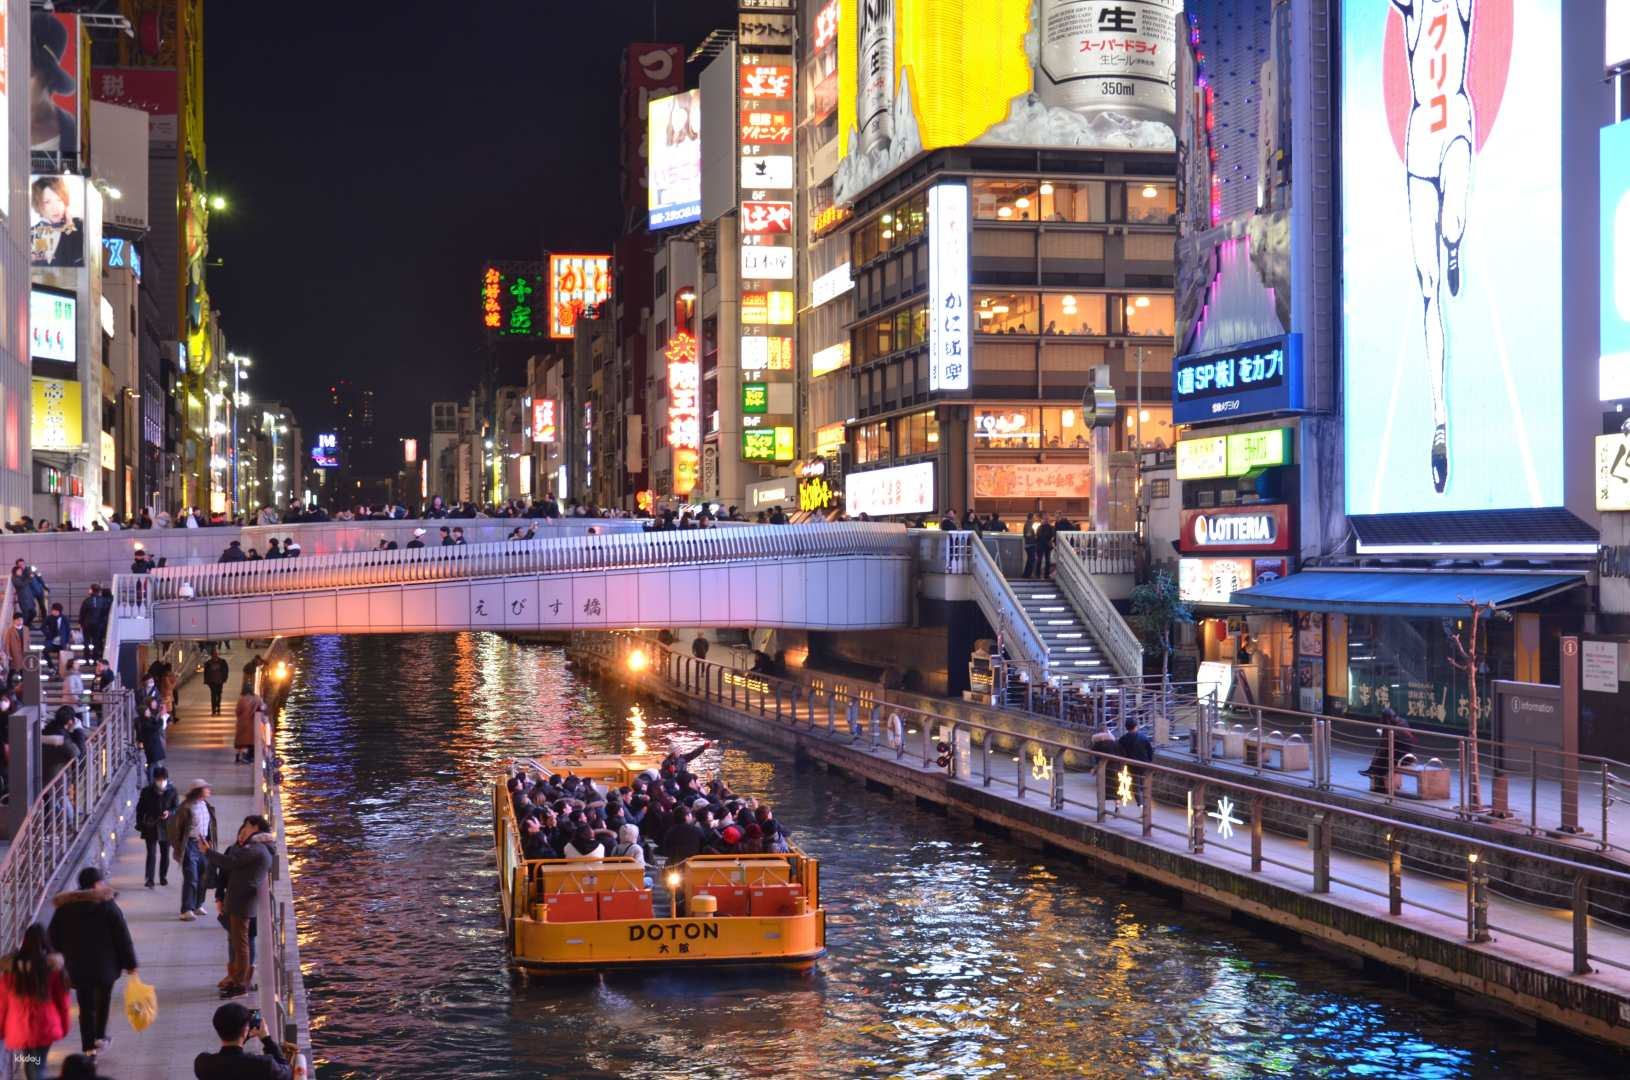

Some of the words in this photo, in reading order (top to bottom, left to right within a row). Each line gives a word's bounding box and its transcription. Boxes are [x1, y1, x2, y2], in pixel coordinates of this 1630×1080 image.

[1098, 6, 1138, 33] 生
[1080, 39, 1157, 55] スーパードライ
[1100, 55, 1136, 66] 生ビール
[1428, 4, 1448, 133] グリコ
[1101, 82, 1136, 97] 350ml
[744, 327, 760, 335] 2F
[944, 291, 963, 381] かに道楽
[744, 372, 760, 380] 1F
[1208, 516, 1271, 541] LOTTERIA
[474, 598, 601, 616] えびす橋
[628, 922, 720, 942] DOTON
